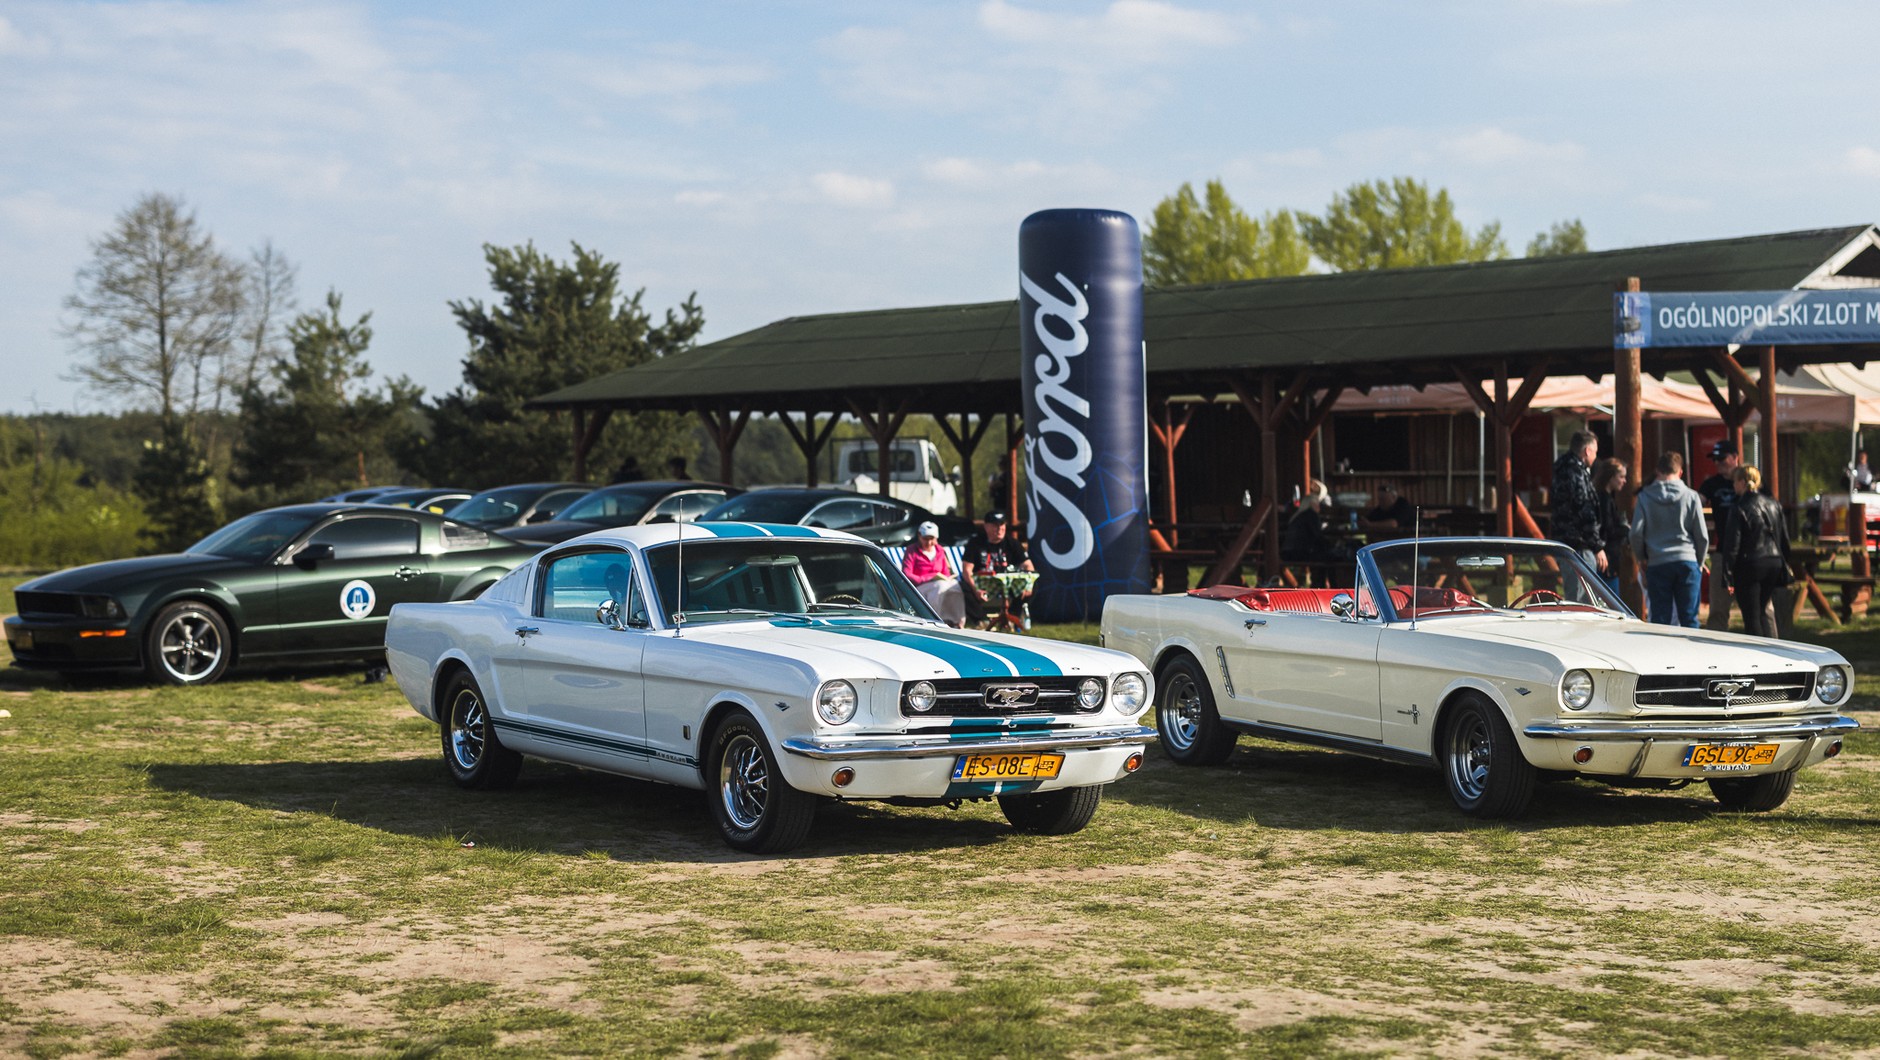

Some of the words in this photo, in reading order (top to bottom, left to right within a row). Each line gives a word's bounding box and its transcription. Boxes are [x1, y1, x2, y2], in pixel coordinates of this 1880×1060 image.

[1659, 302, 1808, 329] OGÓLNOPOLSKI
[1813, 302, 1861, 325] ZLOT
[1020, 271, 1094, 570] Ford
[1694, 747, 1726, 764] GSL
